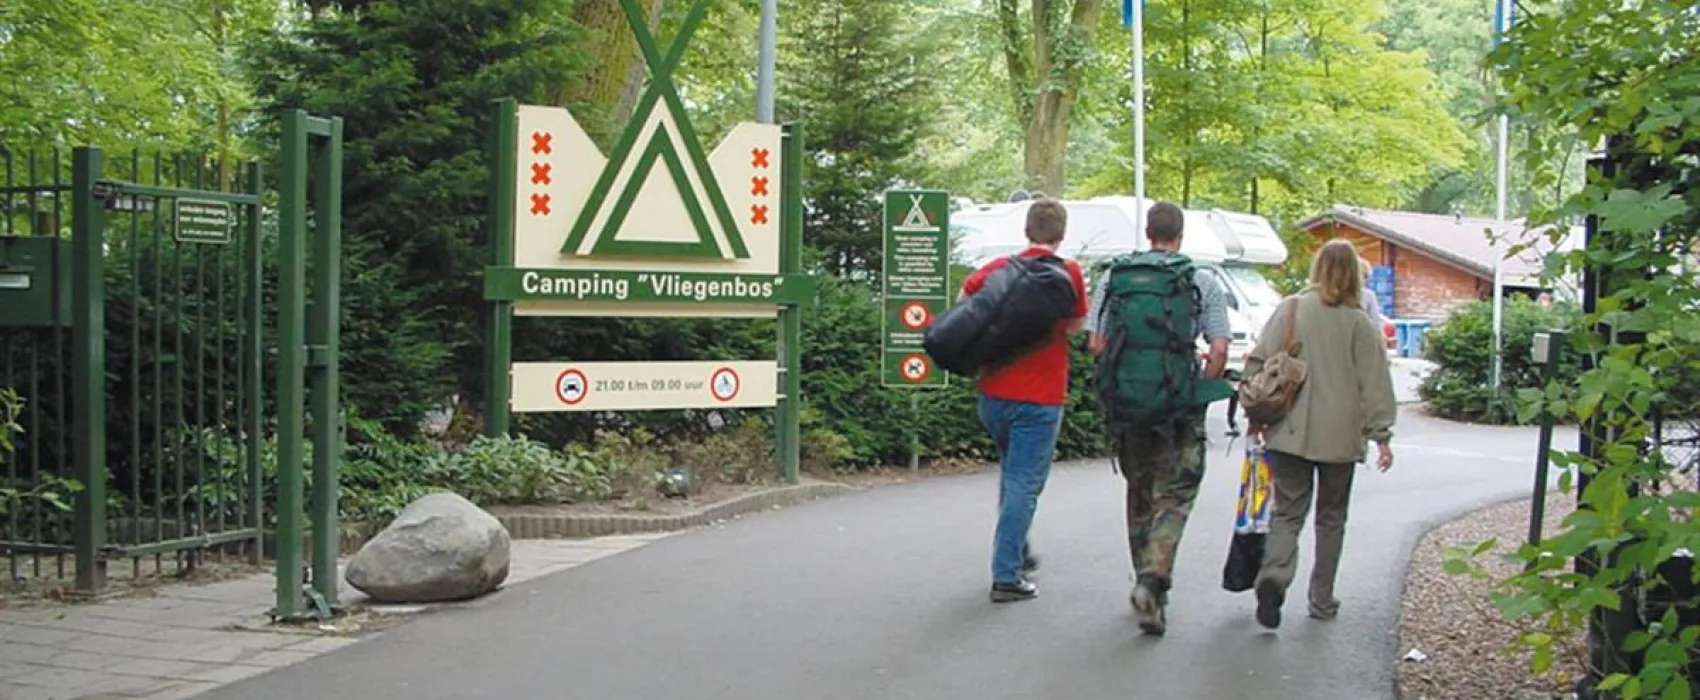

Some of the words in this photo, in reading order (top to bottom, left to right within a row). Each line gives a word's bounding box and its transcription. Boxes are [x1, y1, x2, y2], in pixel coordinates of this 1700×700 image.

[522, 271, 629, 300] Camping
[595, 380, 625, 392] 21.00
[628, 380, 649, 391] t/m
[651, 379, 682, 391] 09.00
[684, 381, 704, 391] uur
